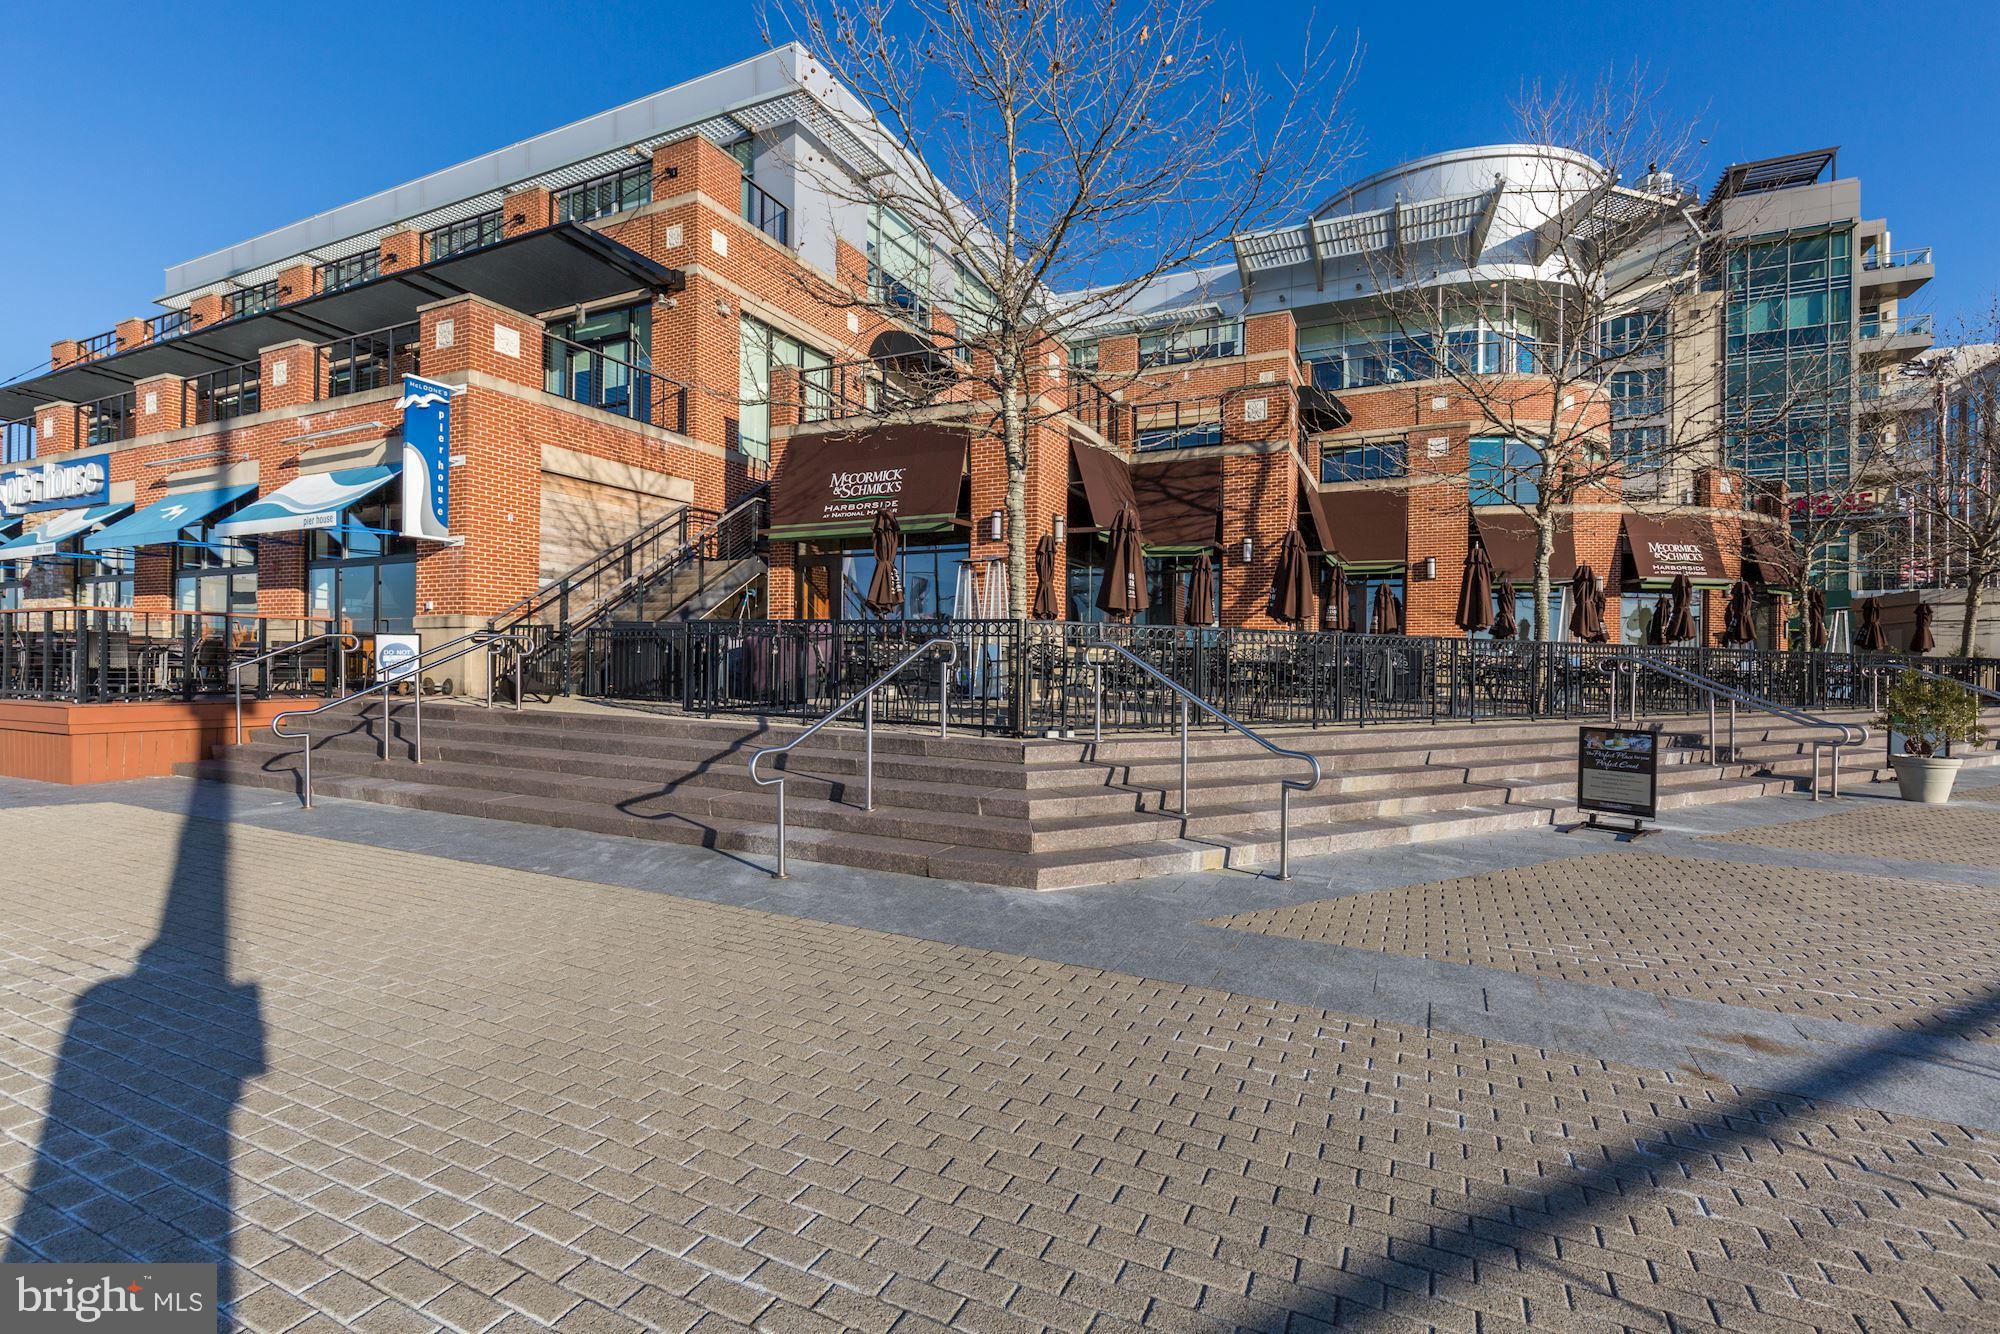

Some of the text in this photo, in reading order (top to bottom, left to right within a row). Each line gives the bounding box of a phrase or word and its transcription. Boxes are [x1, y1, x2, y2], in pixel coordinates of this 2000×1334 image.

[5, 462, 104, 514] pier house
[437, 460, 445, 516] house
[829, 468, 903, 488] McCORMICK
[824, 500, 899, 512] HARBORSIDE
[316, 515, 333, 524] house
